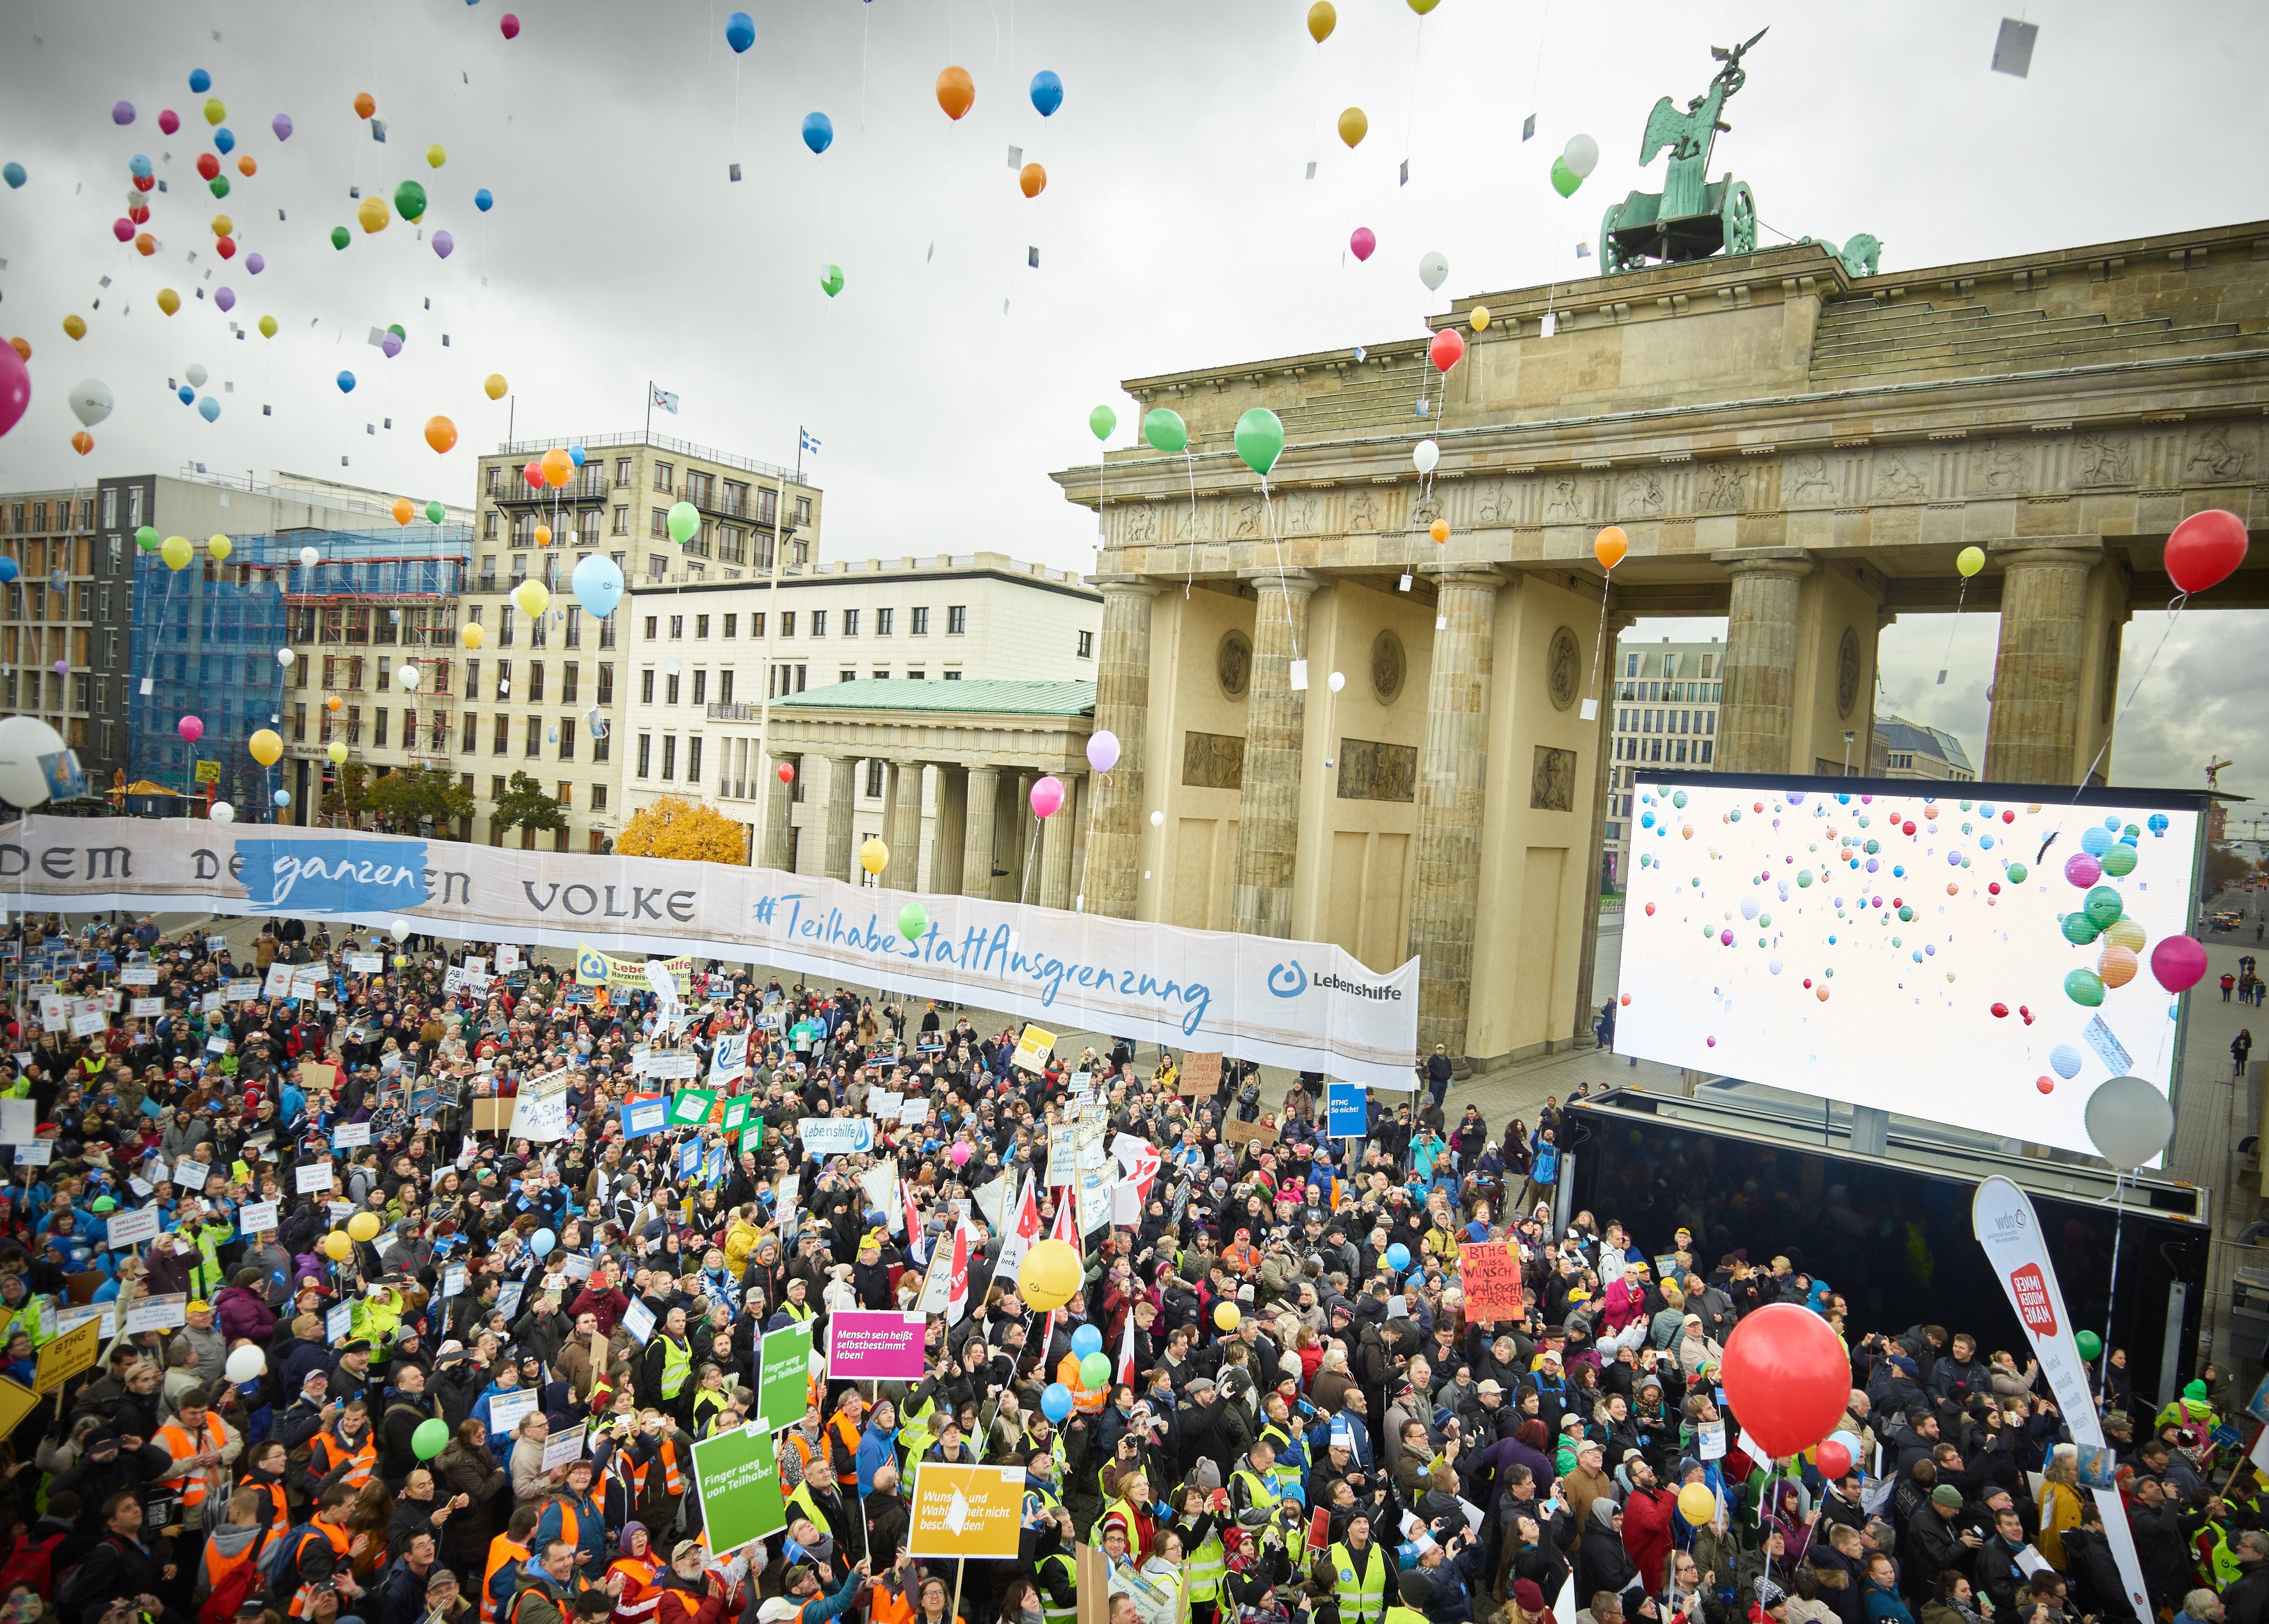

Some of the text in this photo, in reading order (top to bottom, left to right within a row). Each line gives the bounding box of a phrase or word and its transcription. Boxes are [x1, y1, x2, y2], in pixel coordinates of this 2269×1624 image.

[273, 855, 416, 904] ganzen
[523, 880, 697, 922] VOLKE
[1313, 971, 1403, 1002] Lebenshilfe
[804, 1123, 856, 1138] Lebenshilfe
[304, 1178, 326, 1187] überall!
[244, 1206, 273, 1217] INKLUSION
[115, 1214, 151, 1226] INKLUSION
[248, 1219, 270, 1228] Haltung!
[113, 1224, 154, 1240] mitmarschieren!
[115, 1222, 146, 1234] probieren
[1469, 1246, 1508, 1259] BTHG
[1464, 1267, 1512, 1278] WUNSCH
[1463, 1282, 1522, 1297] WAHLRECHT
[54, 1330, 86, 1354] BTHG
[838, 1330, 913, 1342] Mensch sein heißt
[836, 1340, 906, 1350] selbstbestimmt
[836, 1351, 864, 1360] leben!
[40, 1348, 92, 1381] blind und taub
[764, 1355, 800, 1374] Finger weg
[763, 1362, 806, 1385] von Teilhabe!
[704, 1459, 760, 1487] Finger weg
[706, 1465, 773, 1499] von Teilhabe!
[968, 1492, 988, 1503] und
[985, 1506, 1011, 1518] nicht
